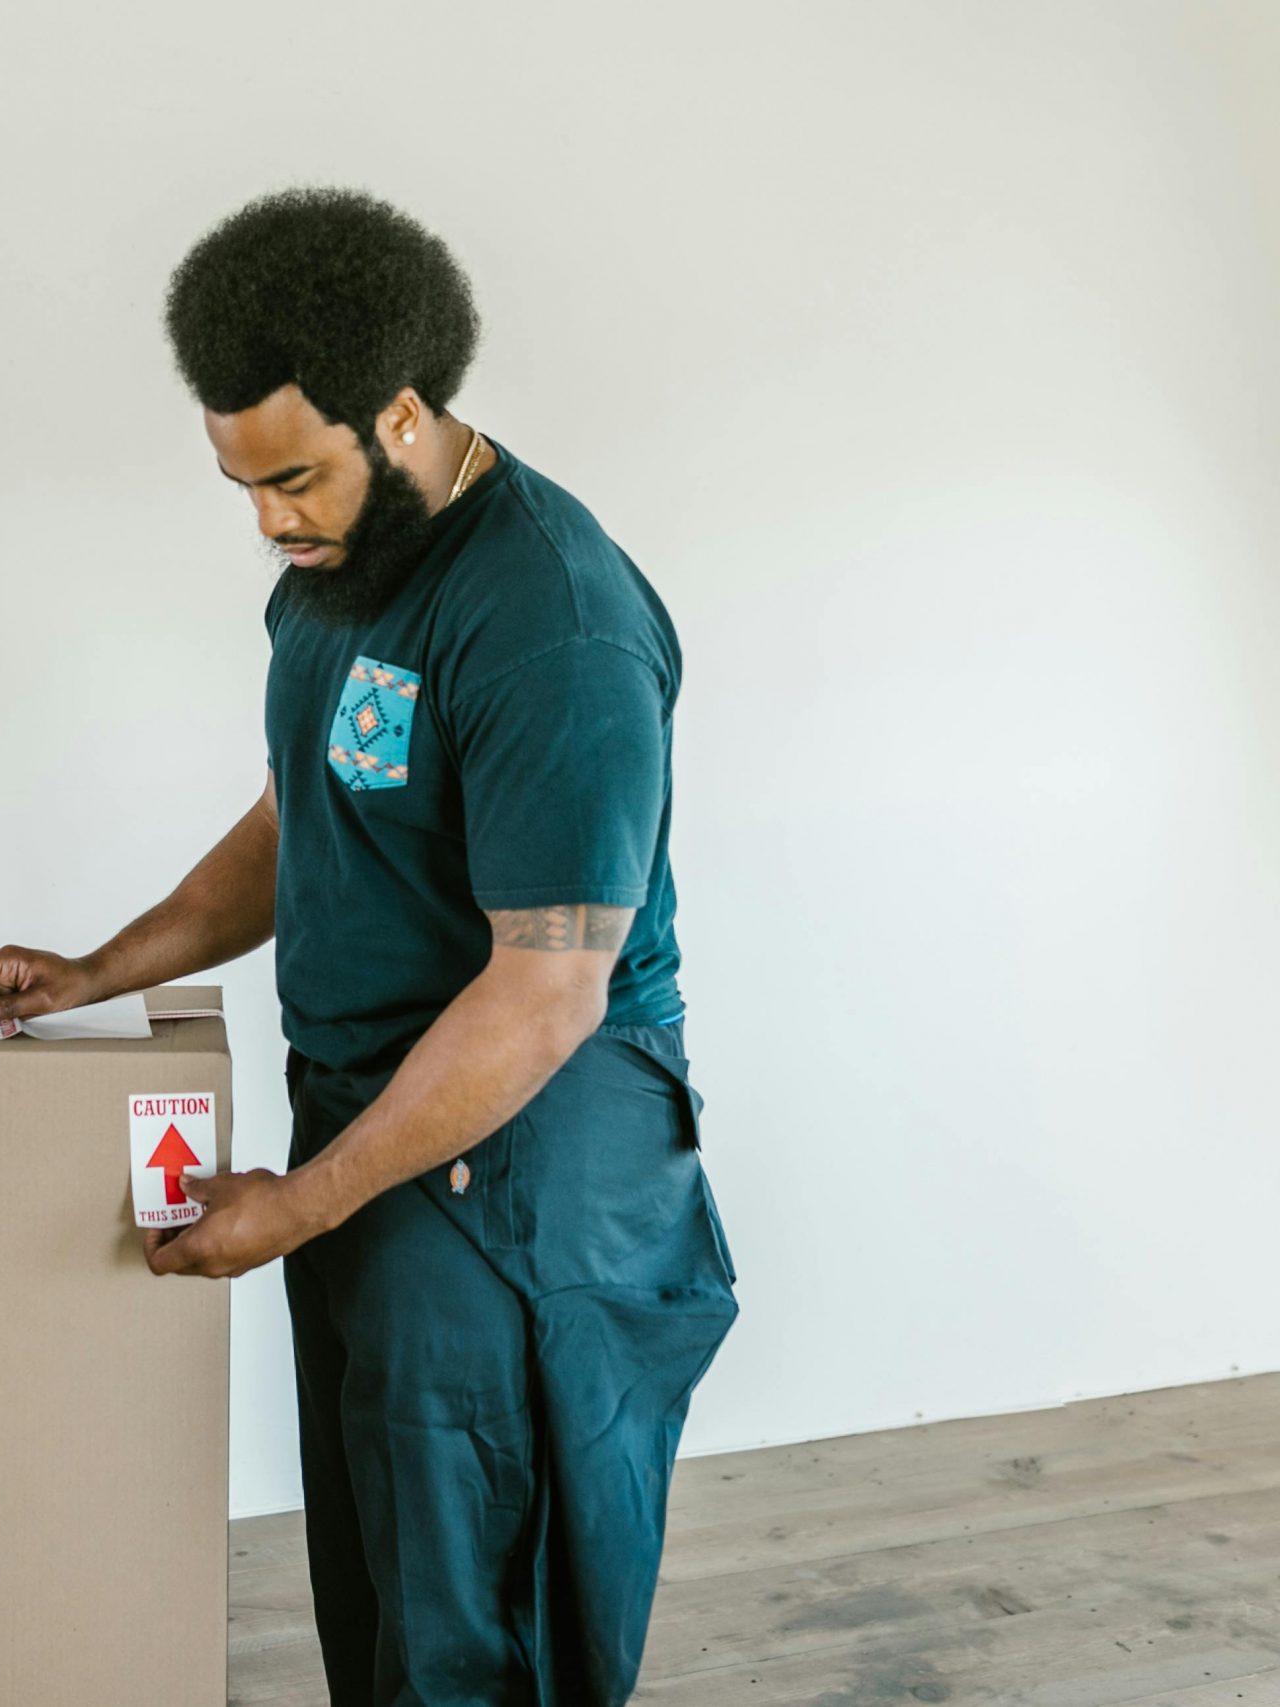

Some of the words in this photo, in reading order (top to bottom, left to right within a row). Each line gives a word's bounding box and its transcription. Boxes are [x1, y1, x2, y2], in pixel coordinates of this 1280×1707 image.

[133, 1098, 210, 1116] CAUTION
[139, 1210, 168, 1222] THIS
[171, 1206, 198, 1220] SIDE
